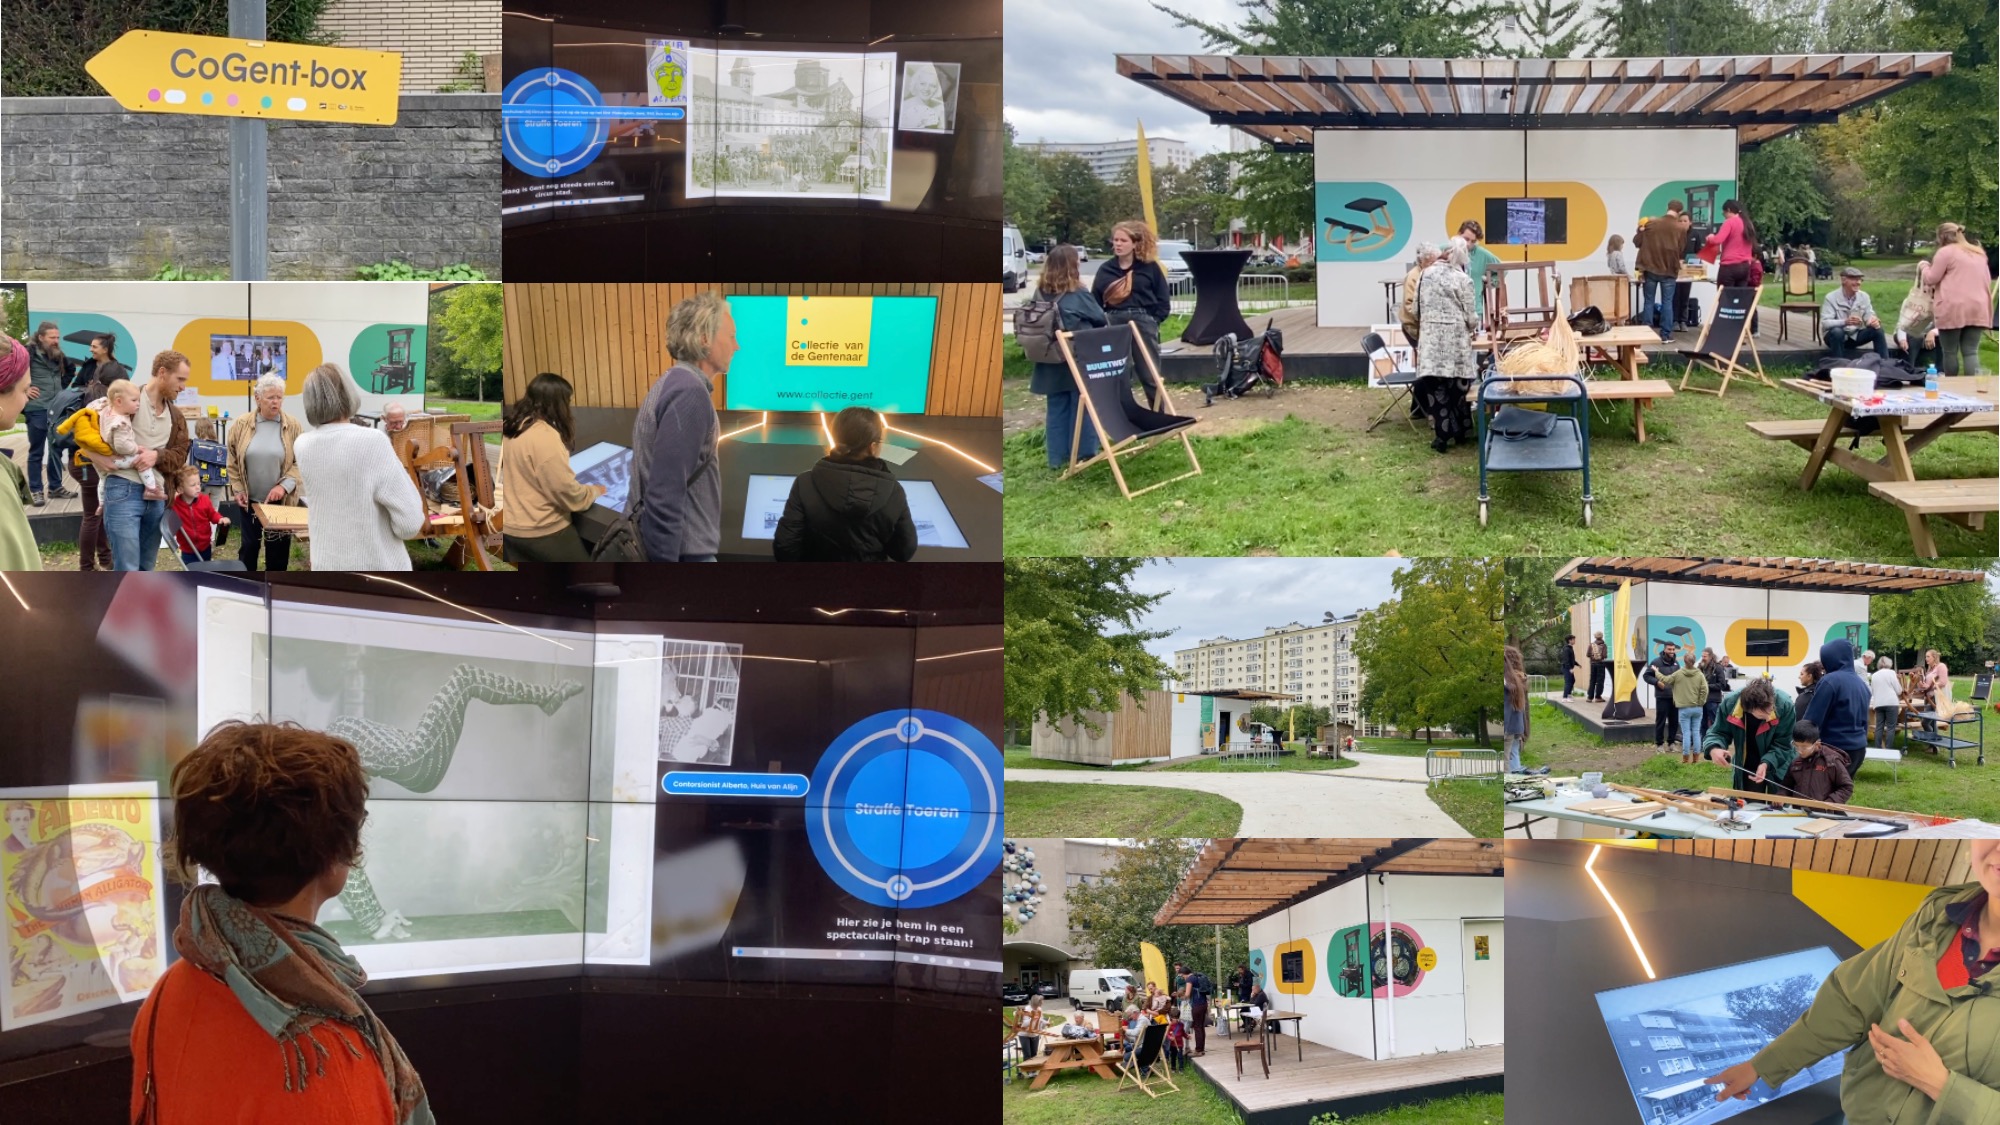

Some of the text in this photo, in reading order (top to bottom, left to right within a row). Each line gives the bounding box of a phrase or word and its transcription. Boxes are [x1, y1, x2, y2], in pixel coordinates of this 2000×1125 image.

[169, 47, 368, 91] CoGent-box
[524, 119, 582, 127] Straffe Toeren
[791, 340, 864, 350] Collectie van
[791, 352, 863, 362] de Gentenaar
[777, 389, 874, 401] www.collectie.gent
[672, 780, 721, 789] Contorsionist
[721, 782, 750, 790] Alberto,
[750, 782, 767, 790] Huis
[782, 783, 799, 792] Alijn
[38, 798, 142, 839] ALBERTO
[855, 802, 960, 819] Straffe Toeren
[95, 879, 149, 898] ALLIGATOR
[836, 917, 964, 934] Hier zie je hem in een
[826, 931, 974, 948] spectaculaire trap staan!
